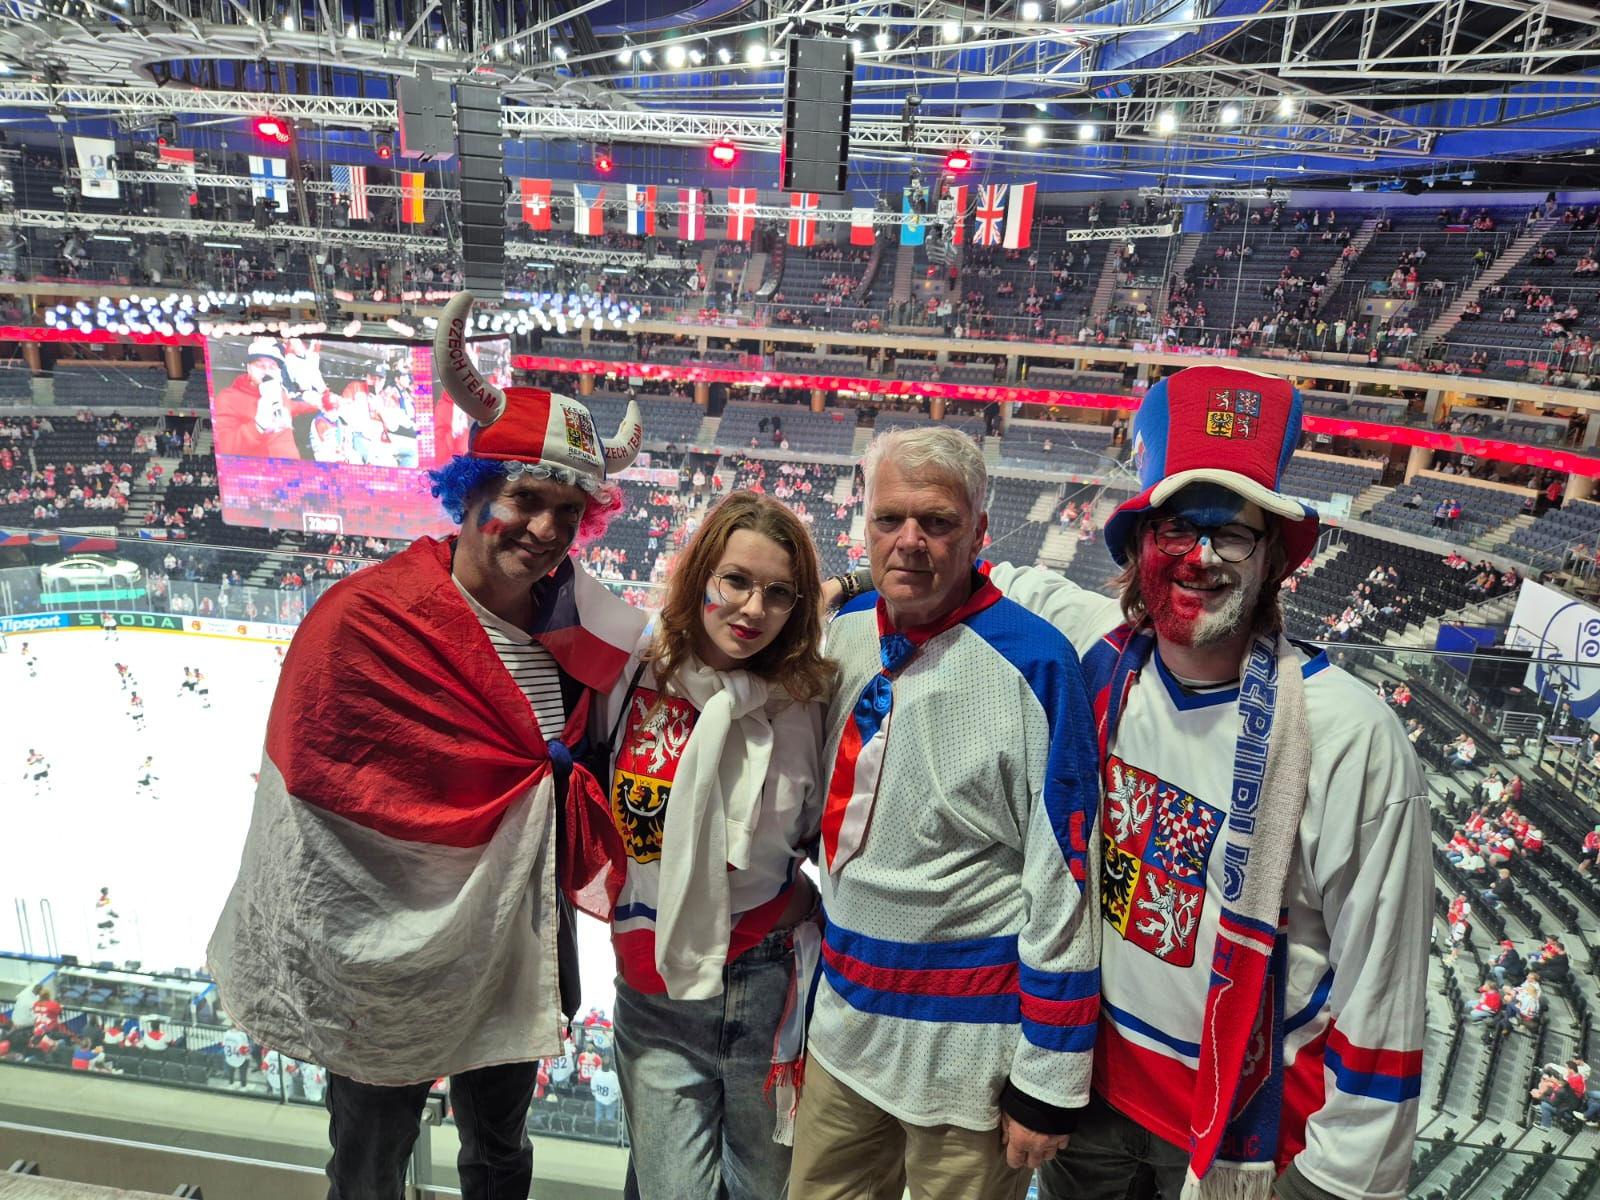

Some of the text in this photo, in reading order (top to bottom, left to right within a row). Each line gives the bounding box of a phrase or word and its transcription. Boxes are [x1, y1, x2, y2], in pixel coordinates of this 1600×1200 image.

[449, 318, 497, 409] CZECH TEAM
[605, 423, 642, 459] ZECH TEAM
[0, 615, 62, 632] Tipsport
